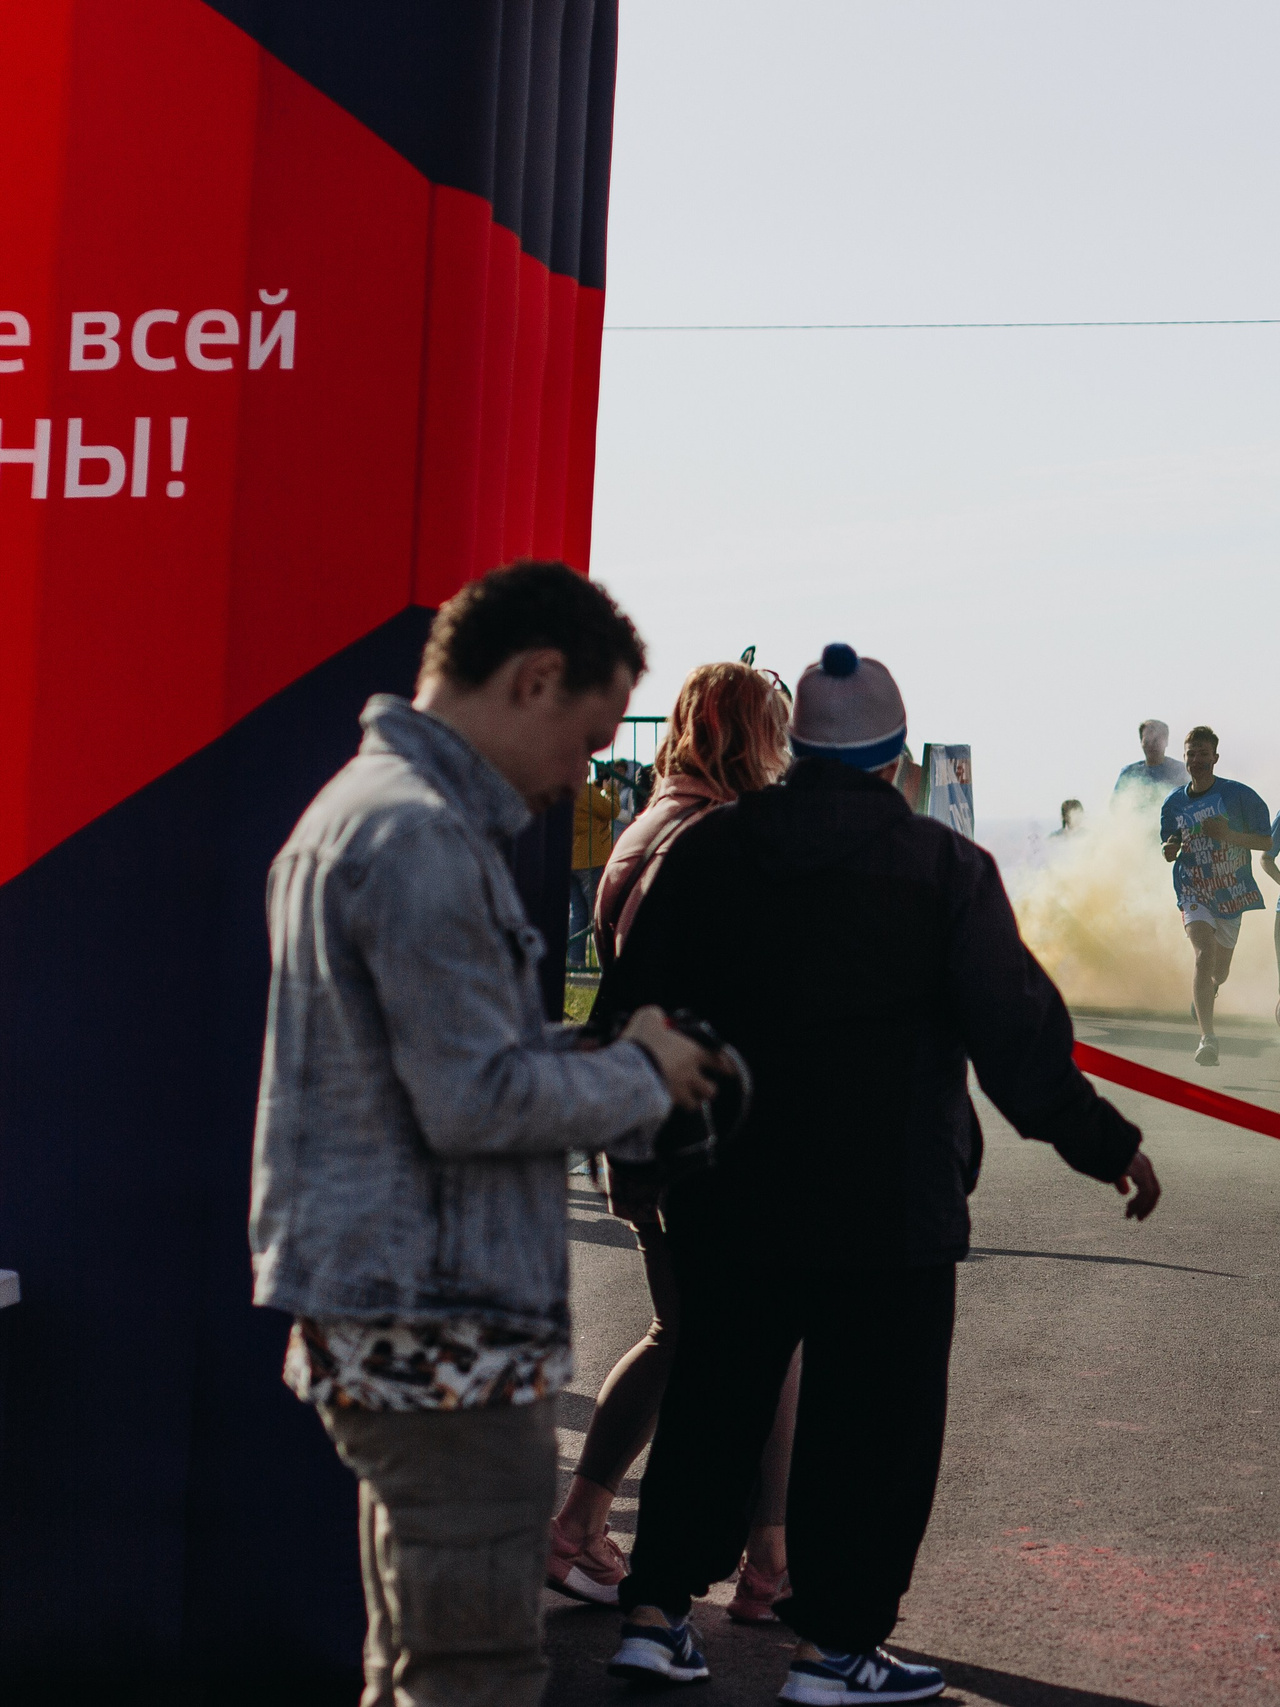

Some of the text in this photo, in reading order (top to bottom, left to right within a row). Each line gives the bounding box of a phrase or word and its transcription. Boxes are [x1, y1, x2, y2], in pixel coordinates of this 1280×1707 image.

[69, 288, 296, 372] всей
[0, 416, 188, 499] НЫ!
[856, 1659, 890, 1691] N
